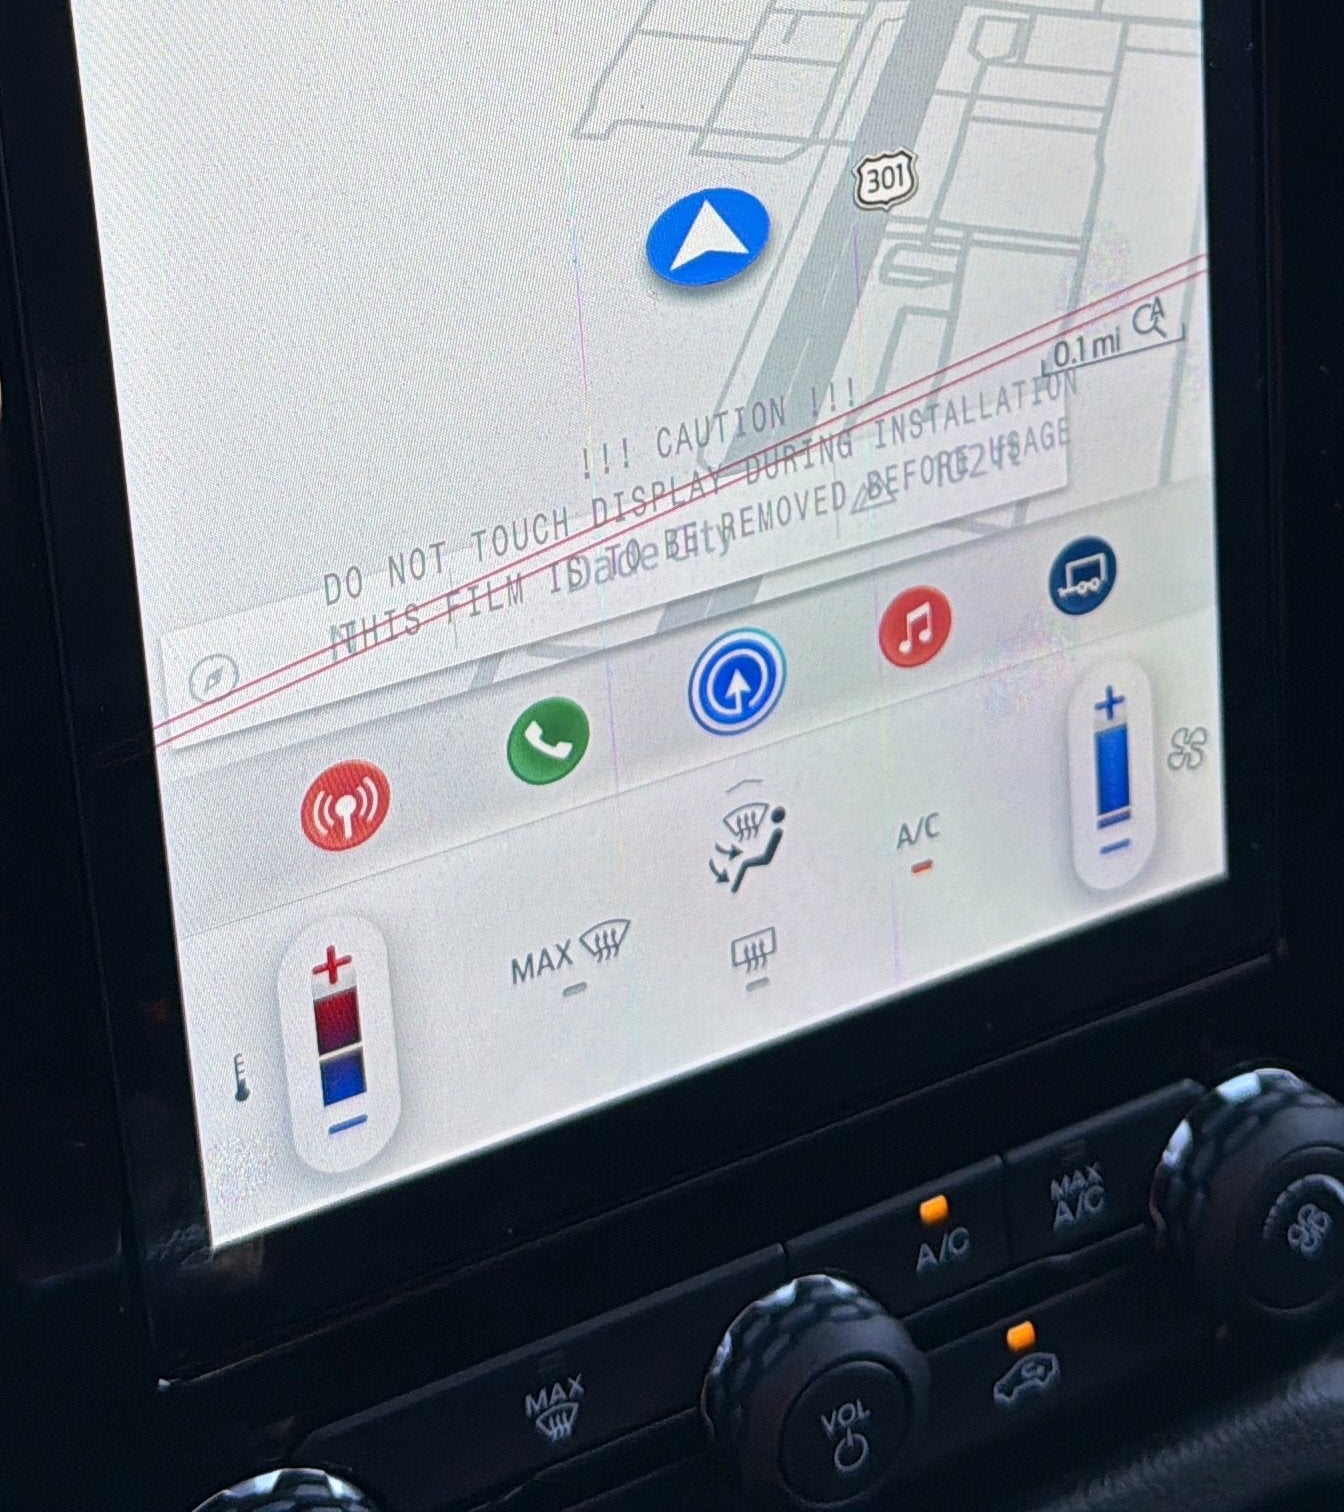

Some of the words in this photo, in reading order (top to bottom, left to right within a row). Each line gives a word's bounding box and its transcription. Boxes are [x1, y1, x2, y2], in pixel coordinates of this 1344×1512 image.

[866, 164, 904, 193] 301
[1053, 335, 1085, 368] 0.1
[1093, 326, 1121, 359] mi
[656, 394, 786, 458] CAUTION
[323, 565, 363, 606] DO
[387, 540, 447, 588] NOT
[471, 506, 569, 562] TOUCH
[591, 462, 724, 529] DISPLAY
[745, 429, 854, 486] DURING
[875, 370, 1079, 449] INSTALLATION
[340, 602, 421, 654] THIS
[446, 571, 524, 626] FILM
[550, 554, 583, 594] IS
[605, 538, 641, 578] TO
[664, 521, 698, 560] BE
[721, 479, 847, 542] REMOVED
[867, 443, 968, 501] BEFORE
[989, 416, 1072, 465] USAGE
[896, 811, 942, 850] A/C
[511, 938, 575, 985] MAX
[1051, 1161, 1104, 1201] MAX
[1054, 1184, 1105, 1232] A/C
[916, 1226, 970, 1274] A/C
[524, 1373, 585, 1418] MAX
[820, 1397, 871, 1437] VOL
